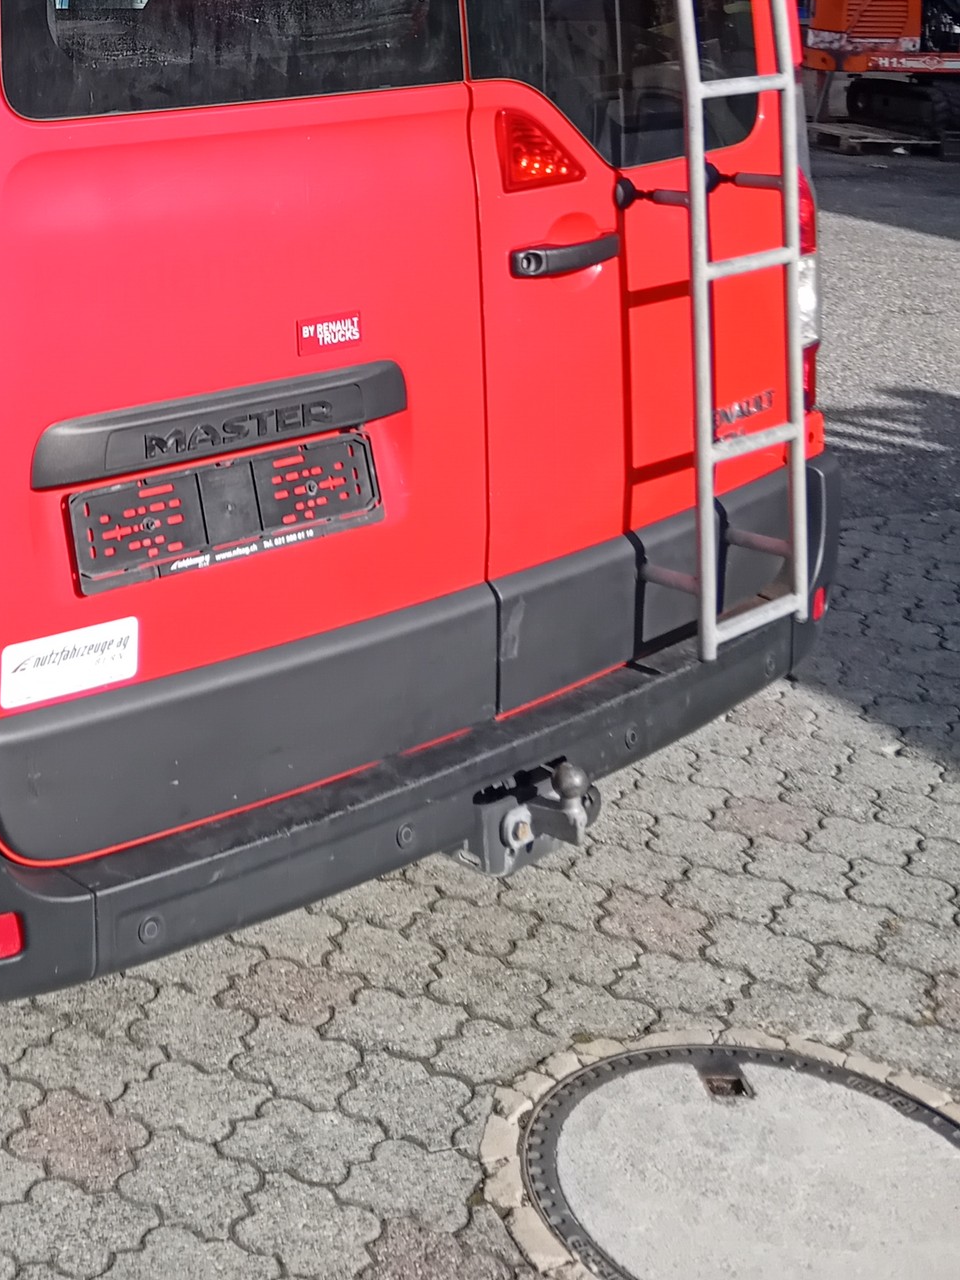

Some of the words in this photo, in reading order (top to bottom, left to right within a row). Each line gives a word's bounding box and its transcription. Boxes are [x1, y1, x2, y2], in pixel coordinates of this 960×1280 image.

[302, 325, 315, 338] BY
[316, 317, 359, 338] RENAULT
[319, 328, 360, 346] TRUCKS
[144, 401, 333, 459] MASTER
[32, 638, 115, 668] nutzfahrzeuge
[116, 634, 131, 650] ag
